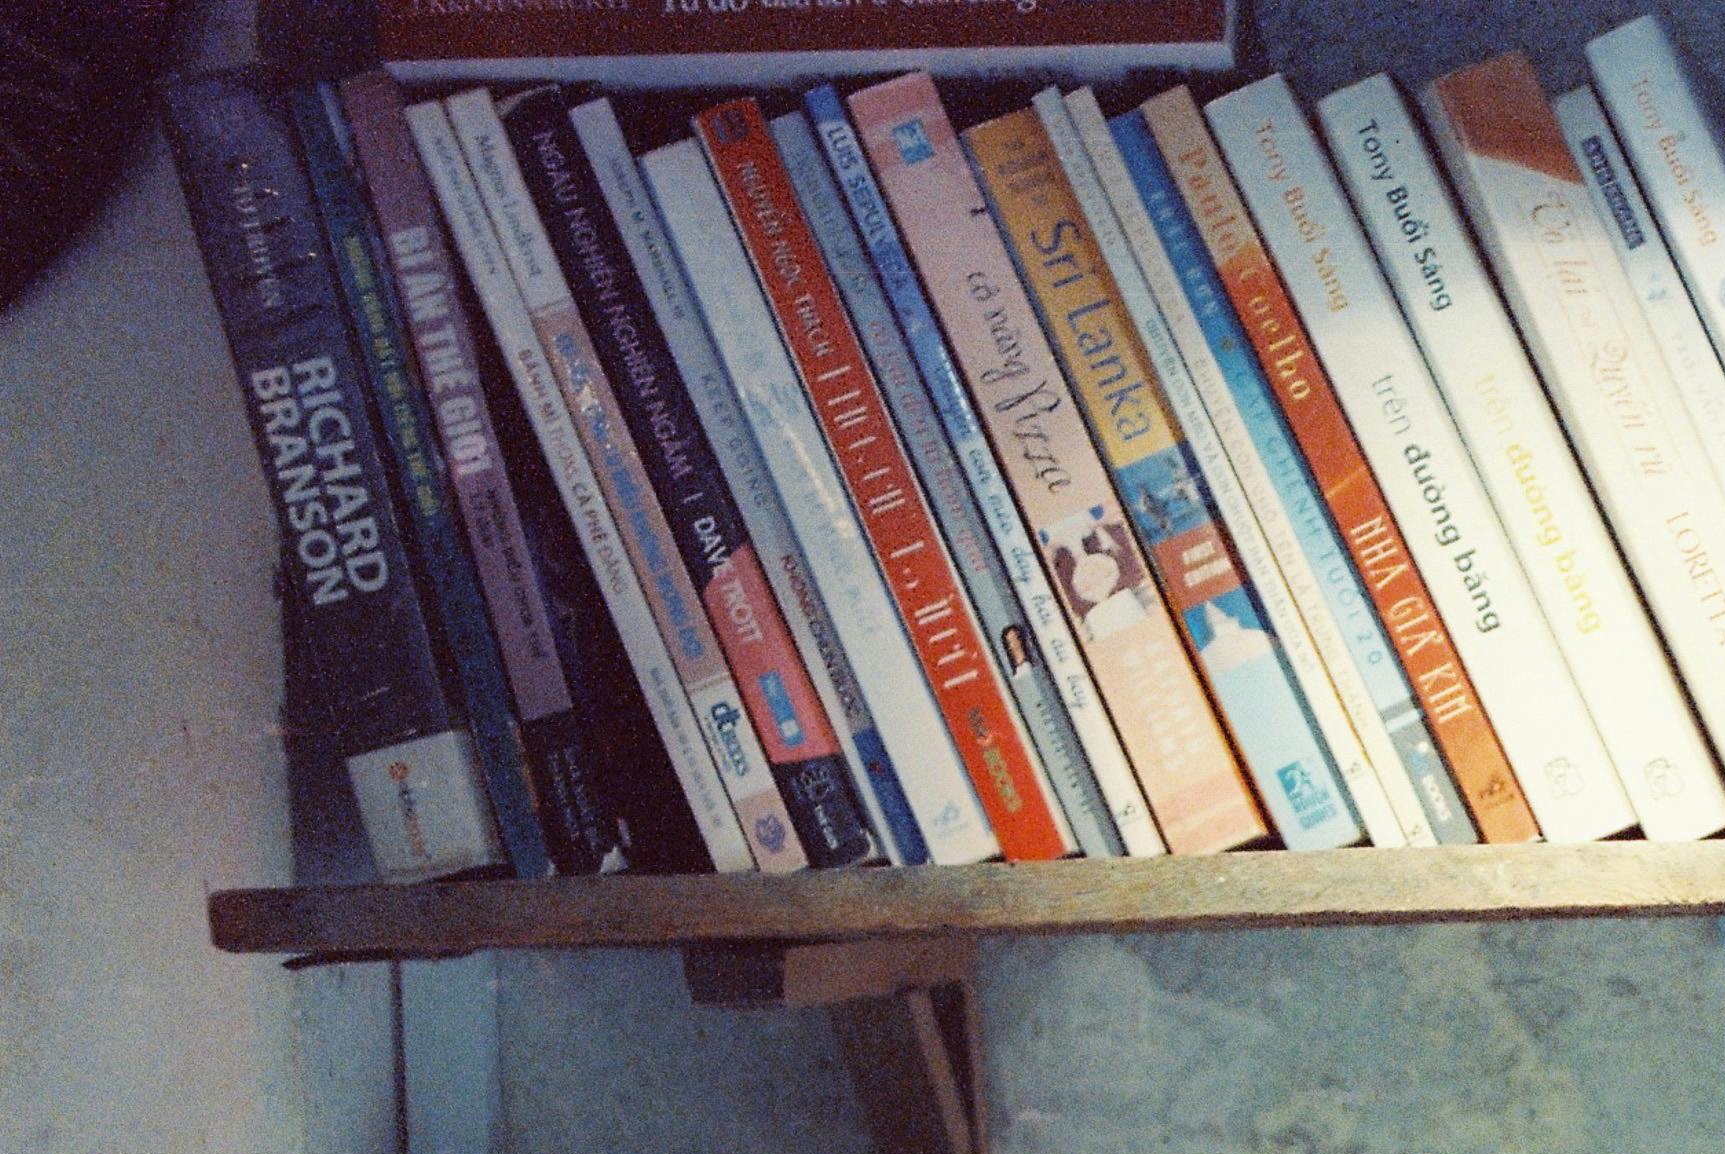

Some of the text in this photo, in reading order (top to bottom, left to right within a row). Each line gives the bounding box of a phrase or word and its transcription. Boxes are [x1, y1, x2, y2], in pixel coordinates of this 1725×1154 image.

[825, 124, 859, 170] LUIS
[1246, 119, 1356, 315] Tony Buổi Sáng
[1349, 118, 1459, 314] Tony Buổi Sáng
[1627, 77, 1668, 133] Tony
[1677, 188, 1721, 248] Sáng
[1028, 214, 1163, 444] Sri Lanka
[1177, 144, 1319, 402] Paulo Coelho
[250, 363, 347, 605] BRANSON
[291, 354, 391, 595] RICHARD
[700, 371, 769, 509] KEEP GOING
[1369, 372, 1508, 633] trên đường băng
[1472, 372, 1611, 636] trên đường băng
[692, 514, 763, 646] DAVE TROTT
[967, 448, 991, 484] con
[1056, 670, 1094, 714] bay
[1355, 629, 1384, 666] 20
[1416, 661, 1474, 725] KIM
